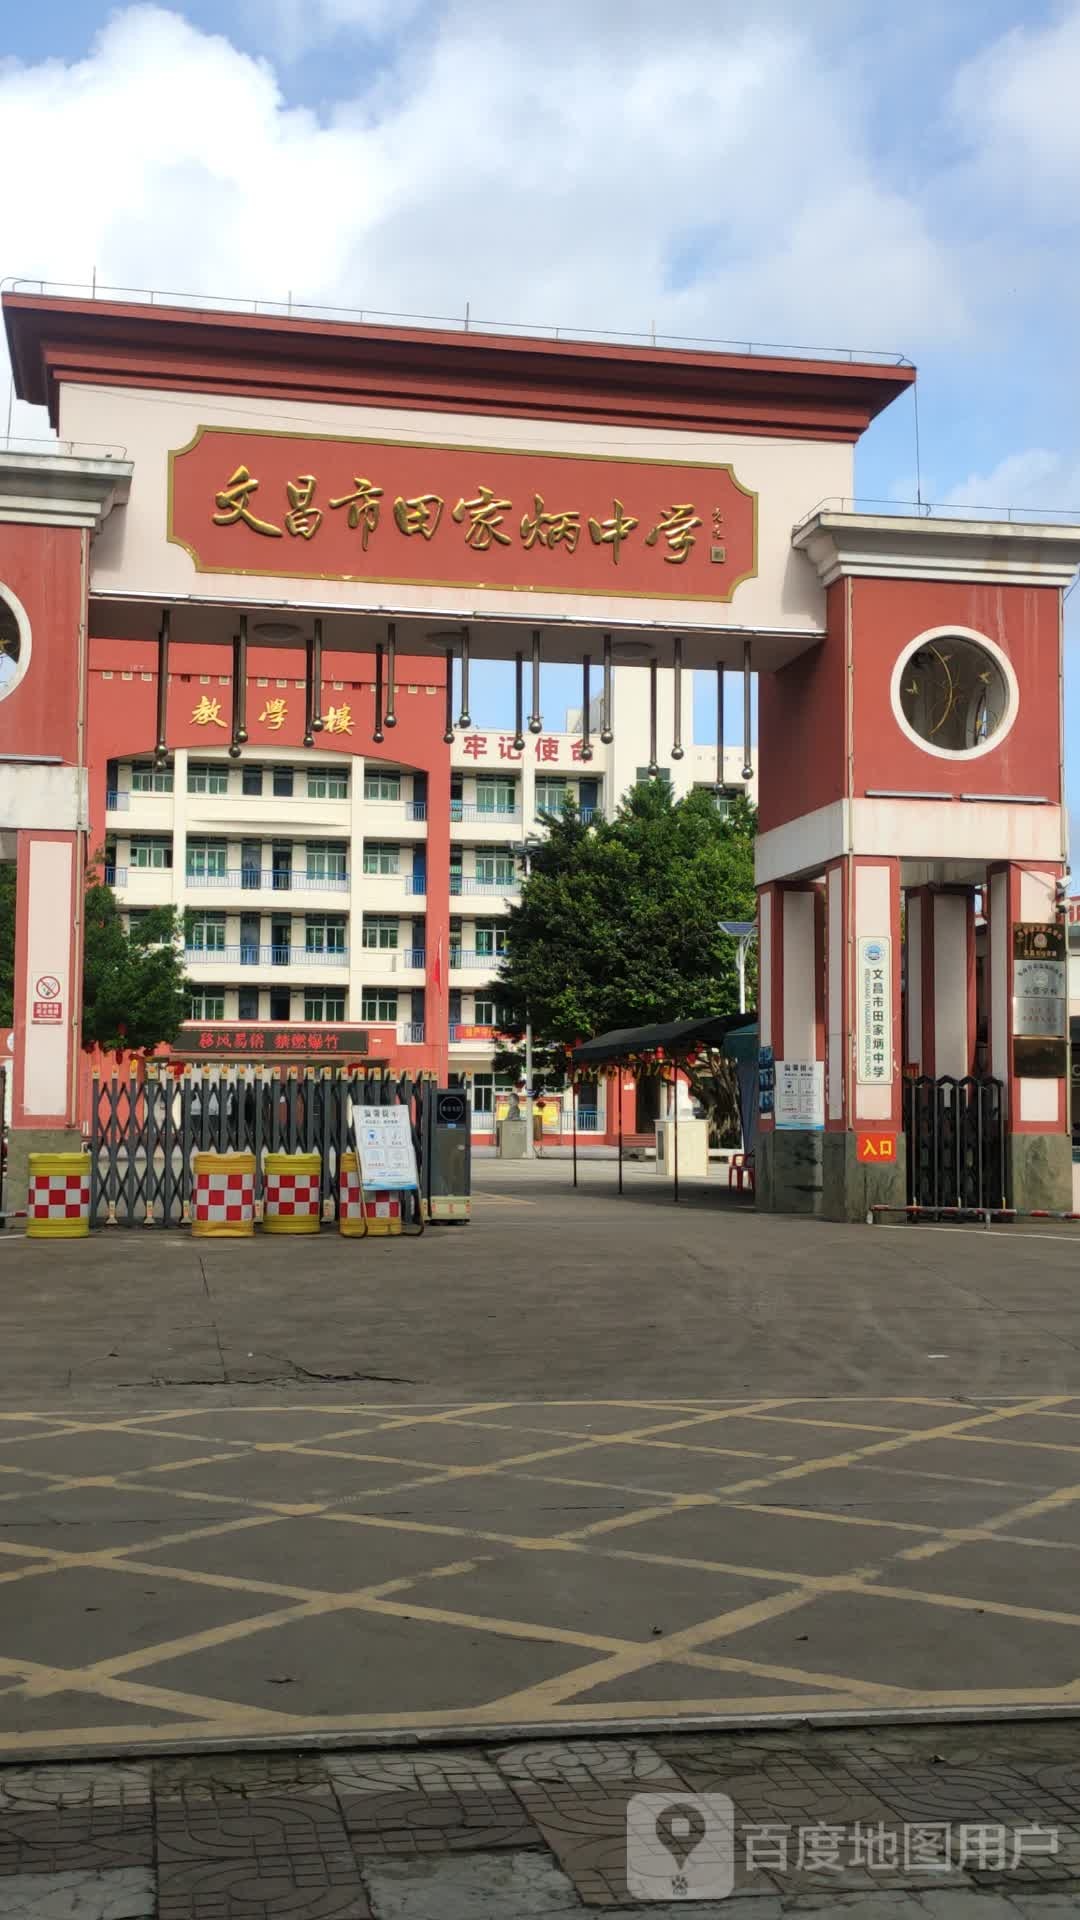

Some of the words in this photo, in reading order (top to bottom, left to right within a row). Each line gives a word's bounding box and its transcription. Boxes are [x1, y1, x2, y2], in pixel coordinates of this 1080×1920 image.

[212, 464, 704, 565] 文昌市田家炳中学
[463, 734, 595, 764] 牢记使命
[872, 969, 885, 1078] 文昌市田家炳中学
[199, 1032, 265, 1049] 移风易俗
[863, 1138, 892, 1156] 入口
